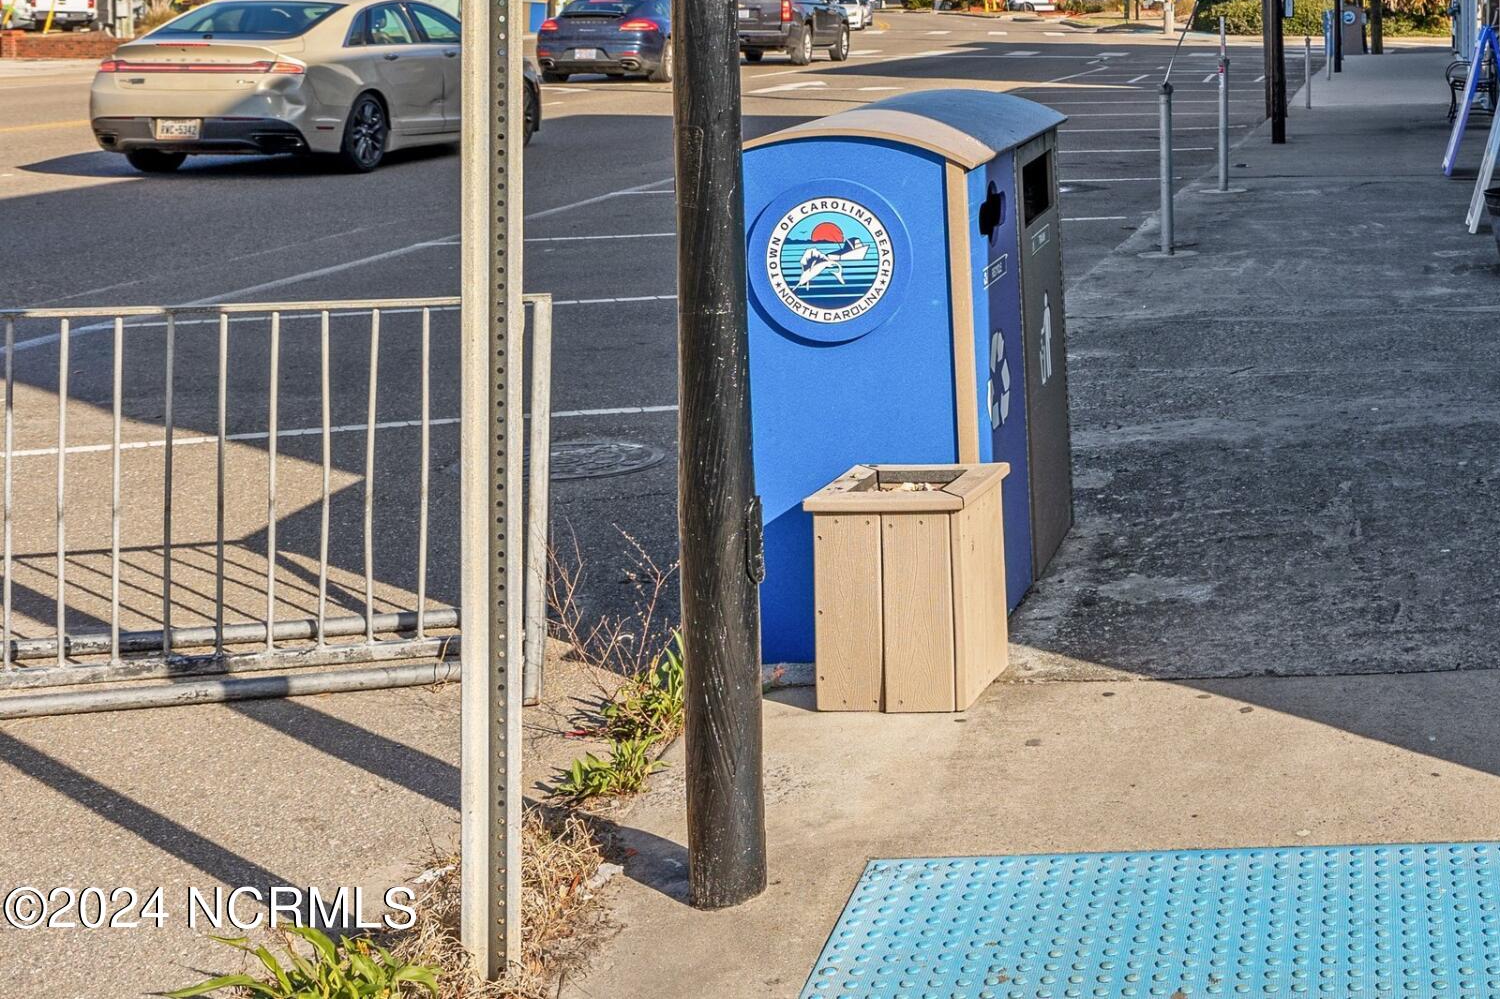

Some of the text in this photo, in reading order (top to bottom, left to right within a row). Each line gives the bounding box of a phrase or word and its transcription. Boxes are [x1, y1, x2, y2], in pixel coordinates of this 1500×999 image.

[769, 200, 891, 279] TOWN OF CAROLINA BEACH
[778, 286, 884, 321] NORTH CAROLINA
